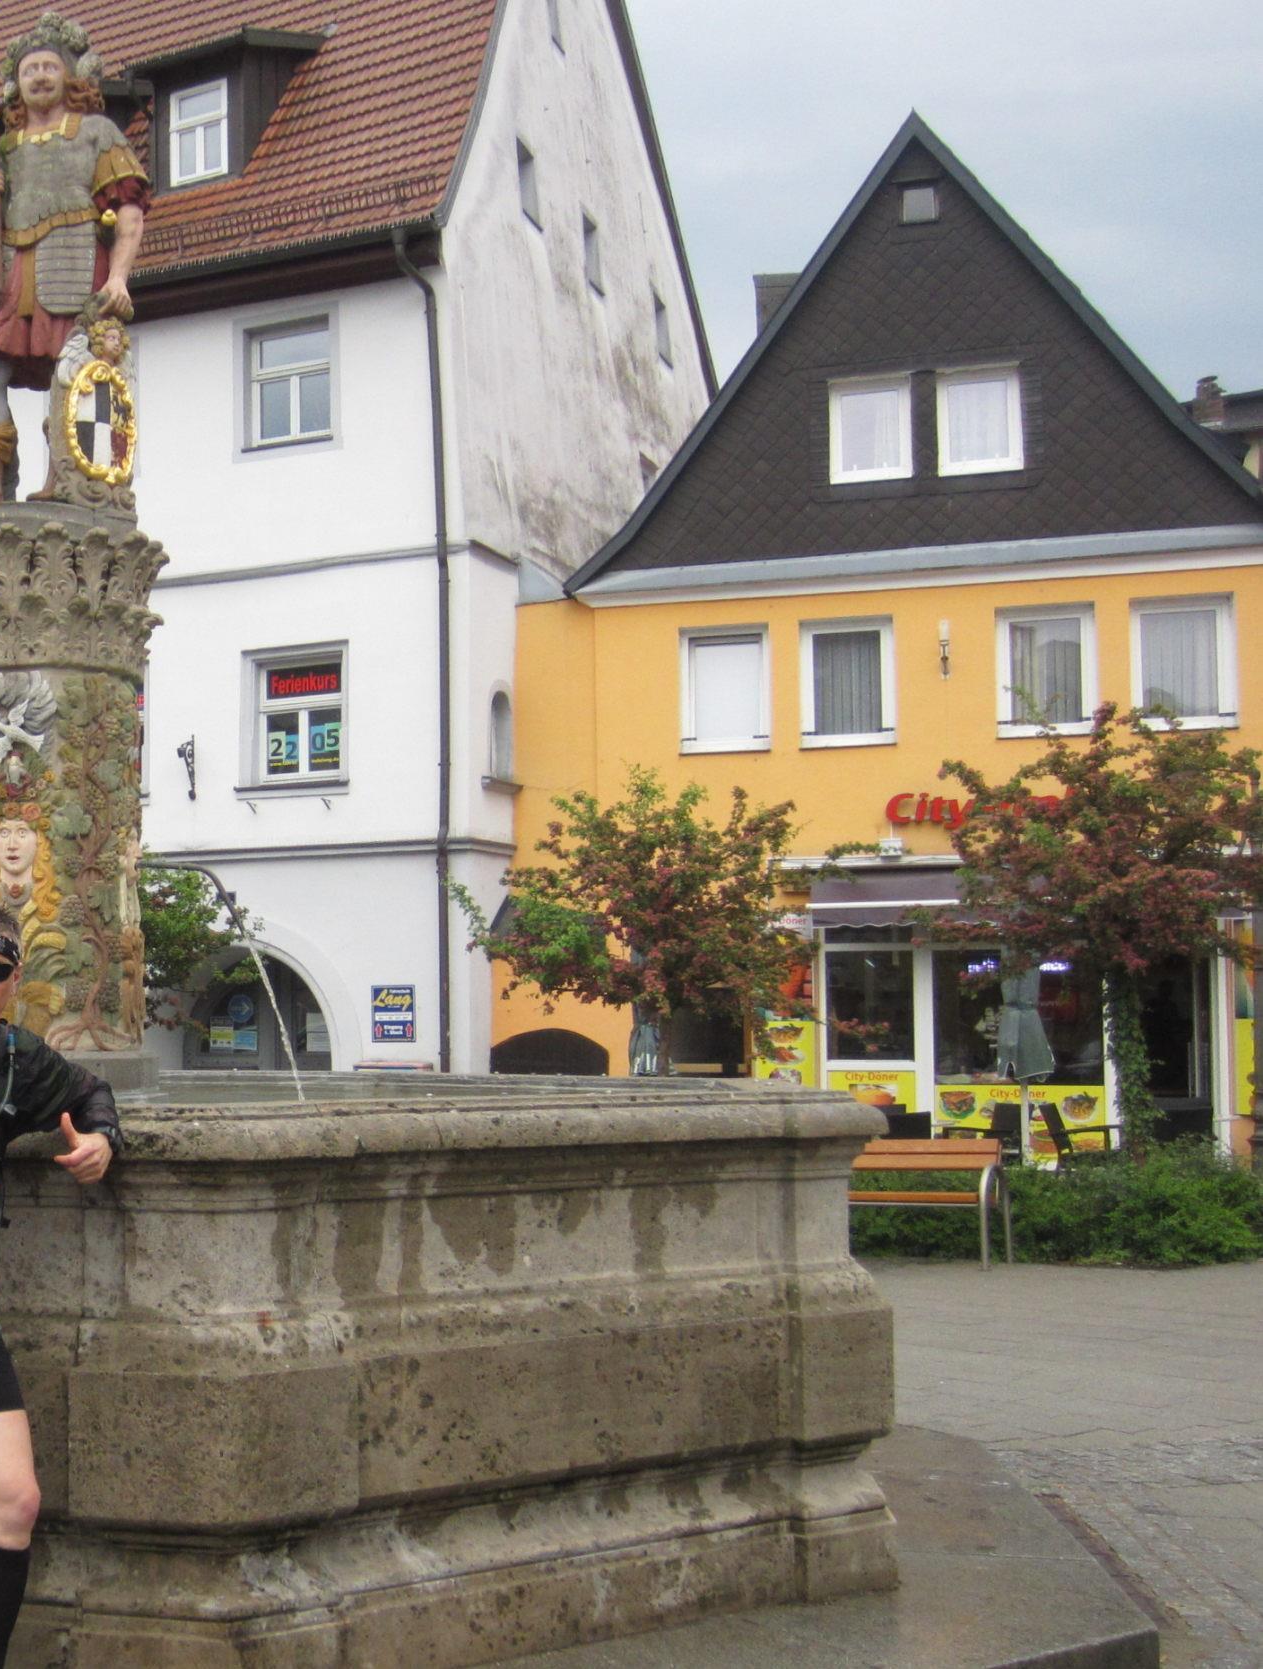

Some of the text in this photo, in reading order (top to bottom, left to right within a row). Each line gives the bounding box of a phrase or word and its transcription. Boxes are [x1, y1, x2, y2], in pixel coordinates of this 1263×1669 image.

[271, 673, 337, 694] Ferienkurs
[372, 989, 412, 1011] Lang
[989, 1088, 1047, 1100] City-Dner
